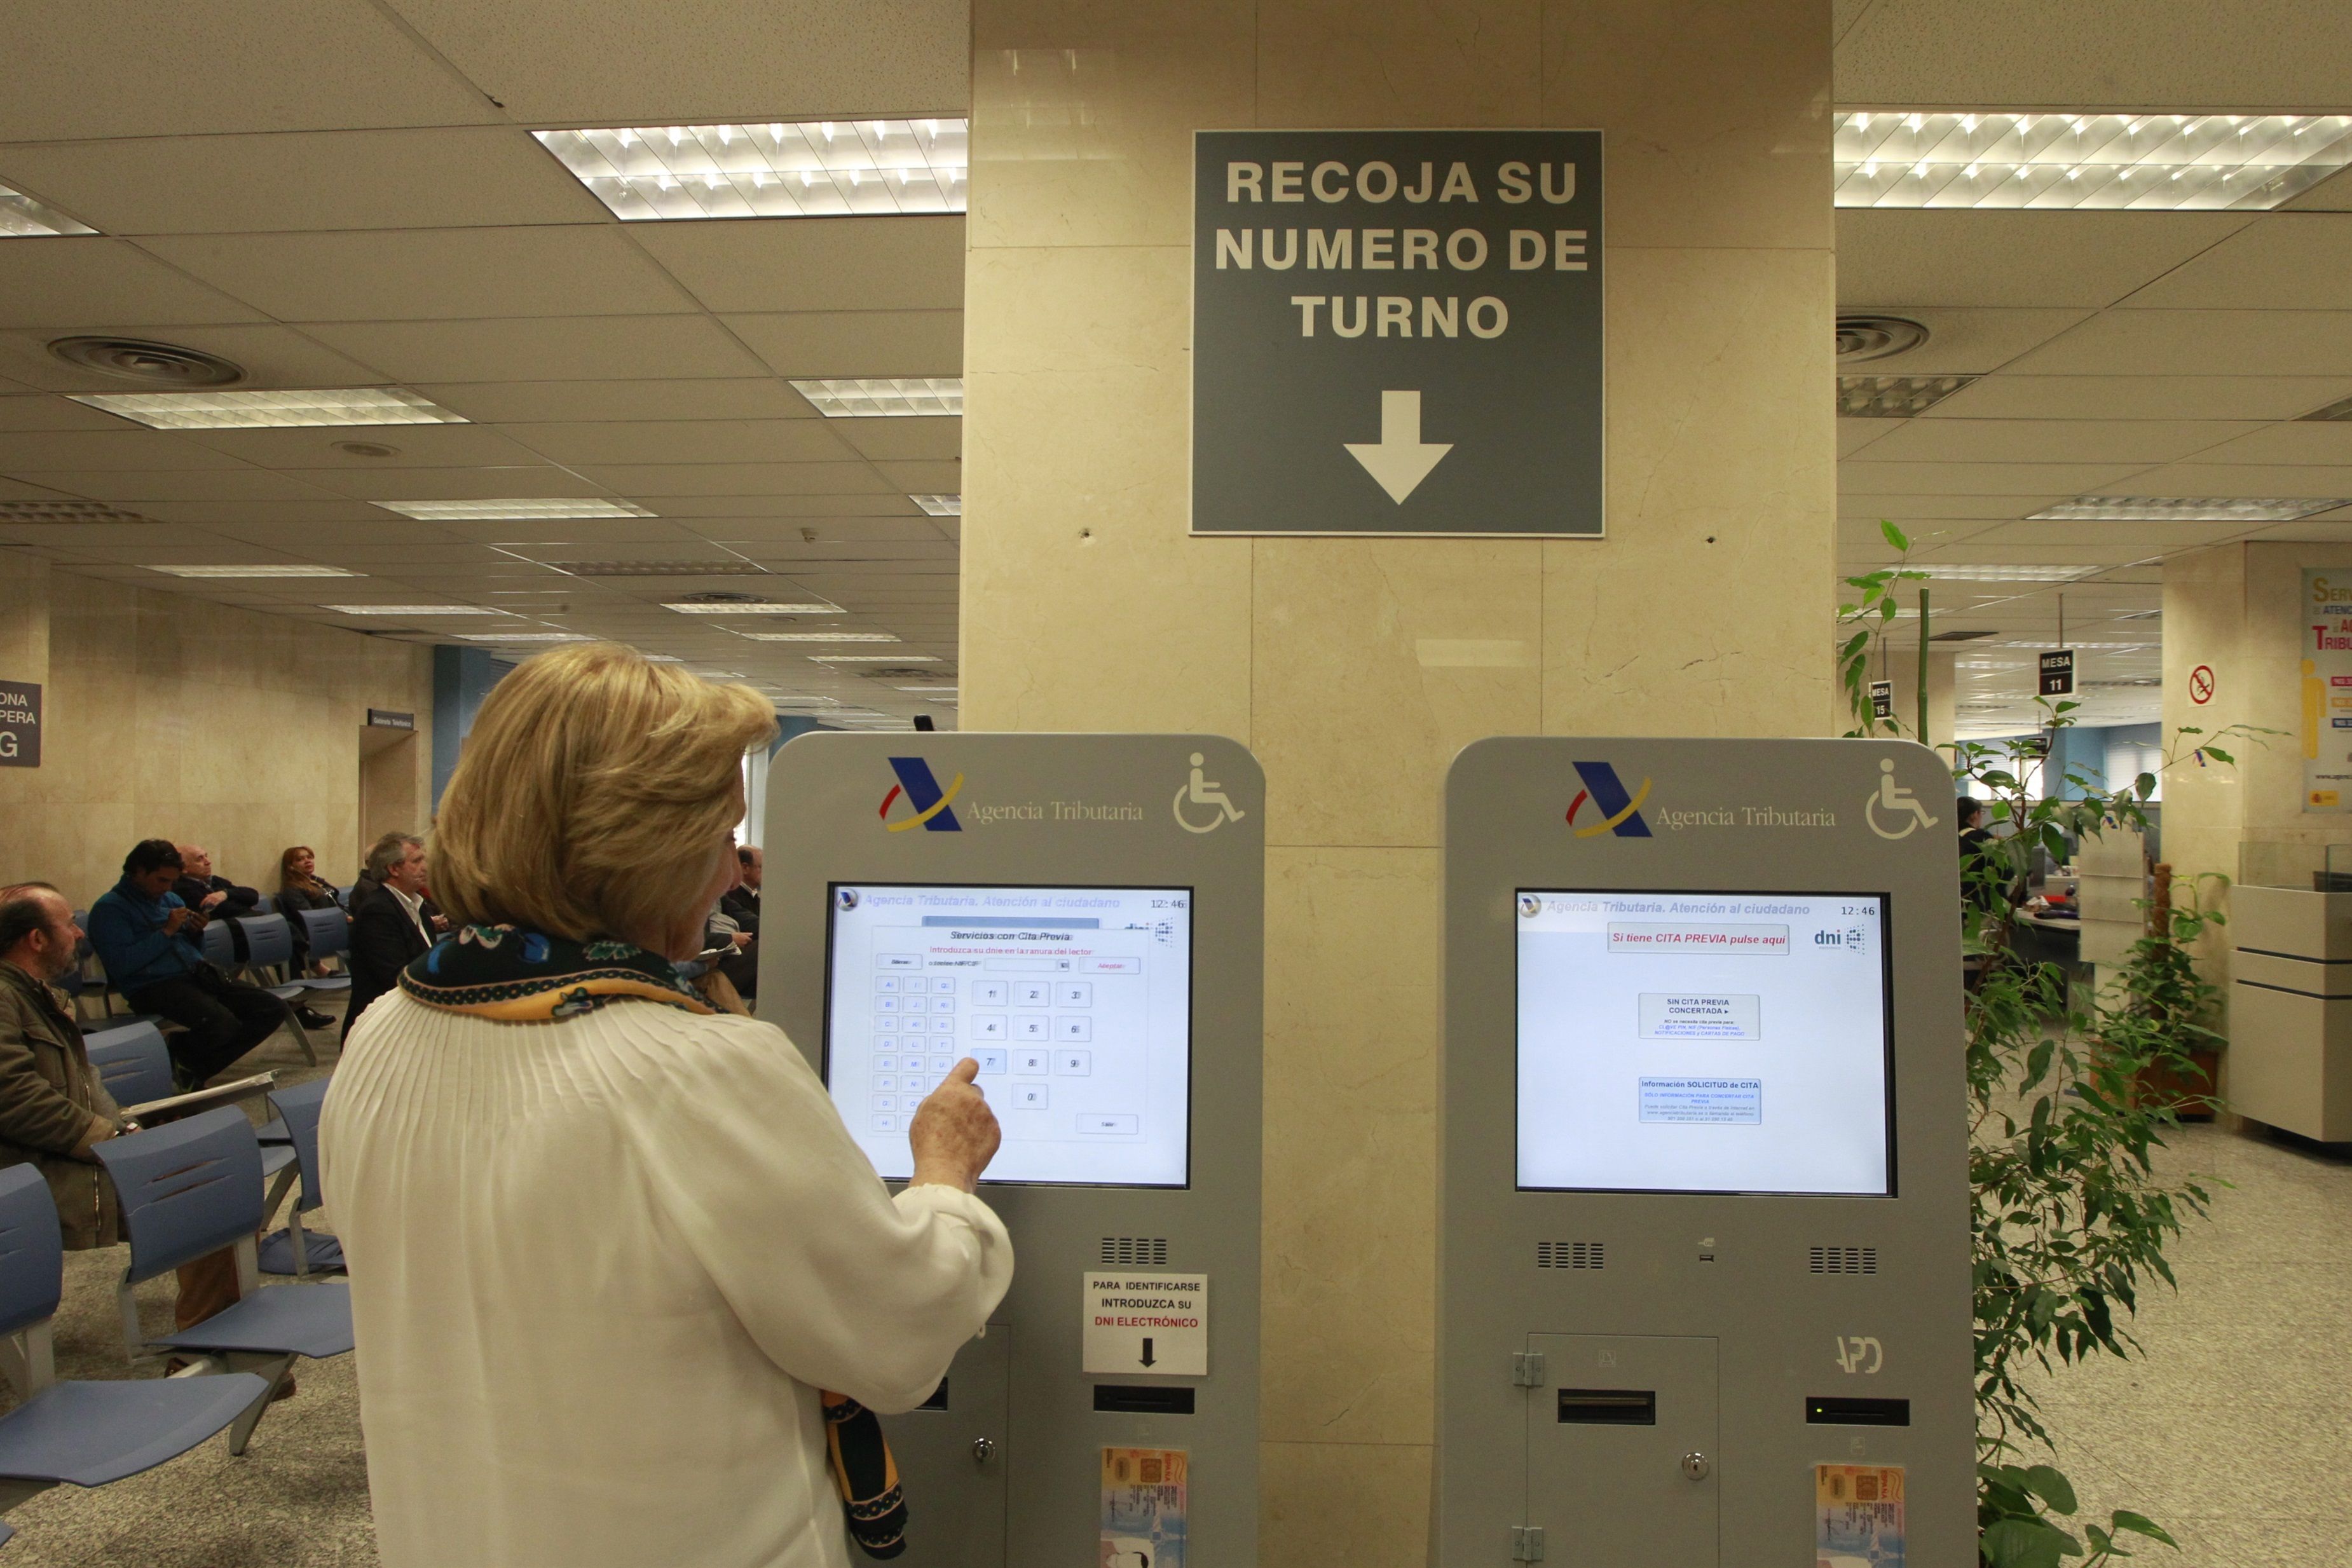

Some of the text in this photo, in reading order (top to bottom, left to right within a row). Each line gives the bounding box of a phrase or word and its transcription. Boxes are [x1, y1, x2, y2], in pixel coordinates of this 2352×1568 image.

[1227, 161, 1576, 204] RECOJA SU
[1215, 228, 1588, 271] NUMERO DE
[1291, 296, 1508, 339] TURNO
[2042, 657, 2070, 669] MESA
[2049, 679, 2061, 691] 11
[1872, 688, 1889, 697] MESA
[1877, 706, 1885, 714] 15
[0, 731, 18, 758] G
[967, 800, 1143, 825] Agencia Tributaria
[1657, 806, 1836, 830] Agencia Tributaria
[864, 895, 1121, 908] Agencia Tributaria. Atención al ciudadano
[1547, 901, 1810, 915] Agencia Tributaria. Atención al ciudadano
[1841, 906, 1875, 916] 12:46
[950, 931, 995, 941] Servicios
[1018, 932, 1039, 941] Cita
[1040, 932, 1072, 941] Previa
[1613, 932, 1787, 946] Si tiene CITA PREVIA pulse aquí
[1814, 929, 1841, 944] dni
[929, 946, 972, 954] Introduzca
[1069, 948, 1092, 956] lector
[1093, 1281, 1200, 1291] PARA IDENTIFICARSE
[1102, 1299, 1191, 1309] INTRODUZCA SU
[1095, 1316, 1198, 1327] DNI ELECTRÓNICO
